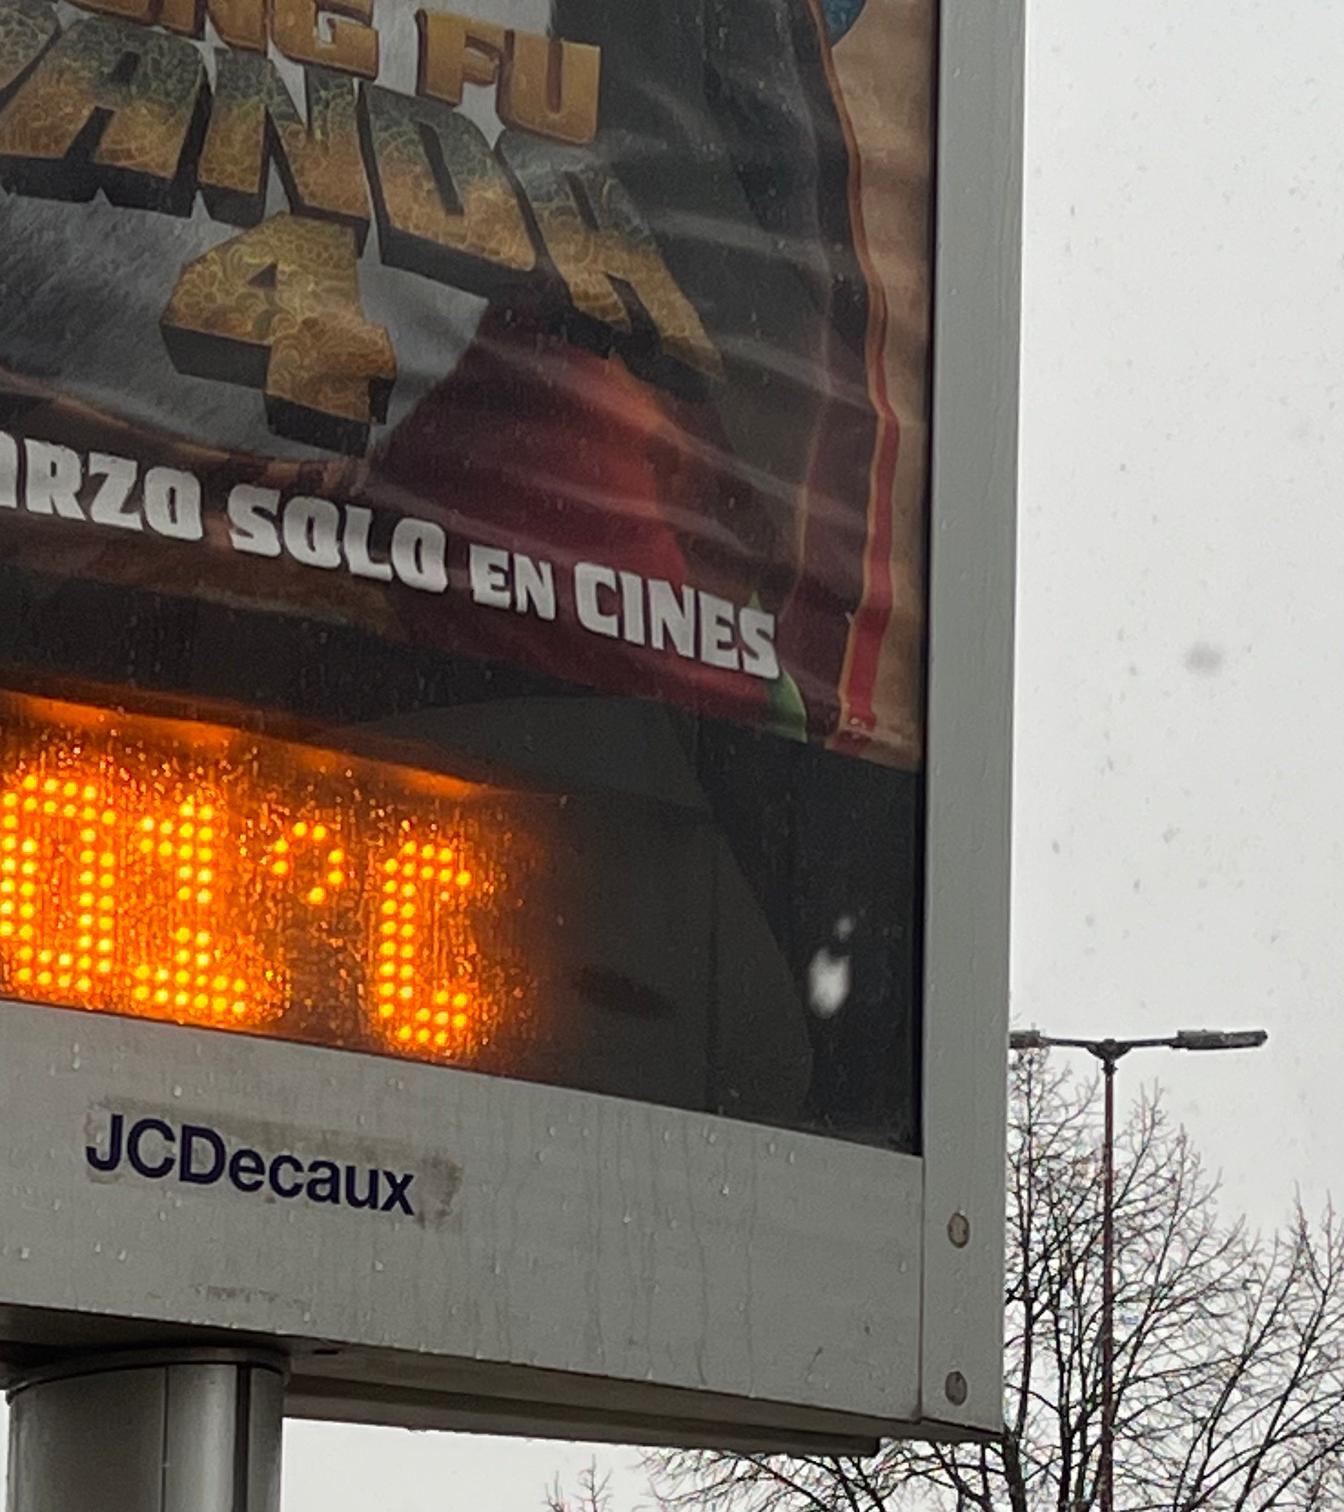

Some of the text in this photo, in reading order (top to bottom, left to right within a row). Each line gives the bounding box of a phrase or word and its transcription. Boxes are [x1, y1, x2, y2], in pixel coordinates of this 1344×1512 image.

[414, 8, 602, 145] FU
[159, 212, 397, 440] 4
[226, 482, 449, 593] SOLO
[468, 542, 555, 621] EN
[574, 561, 781, 680] CINES
[85, 1113, 416, 1217] JCDecaux
